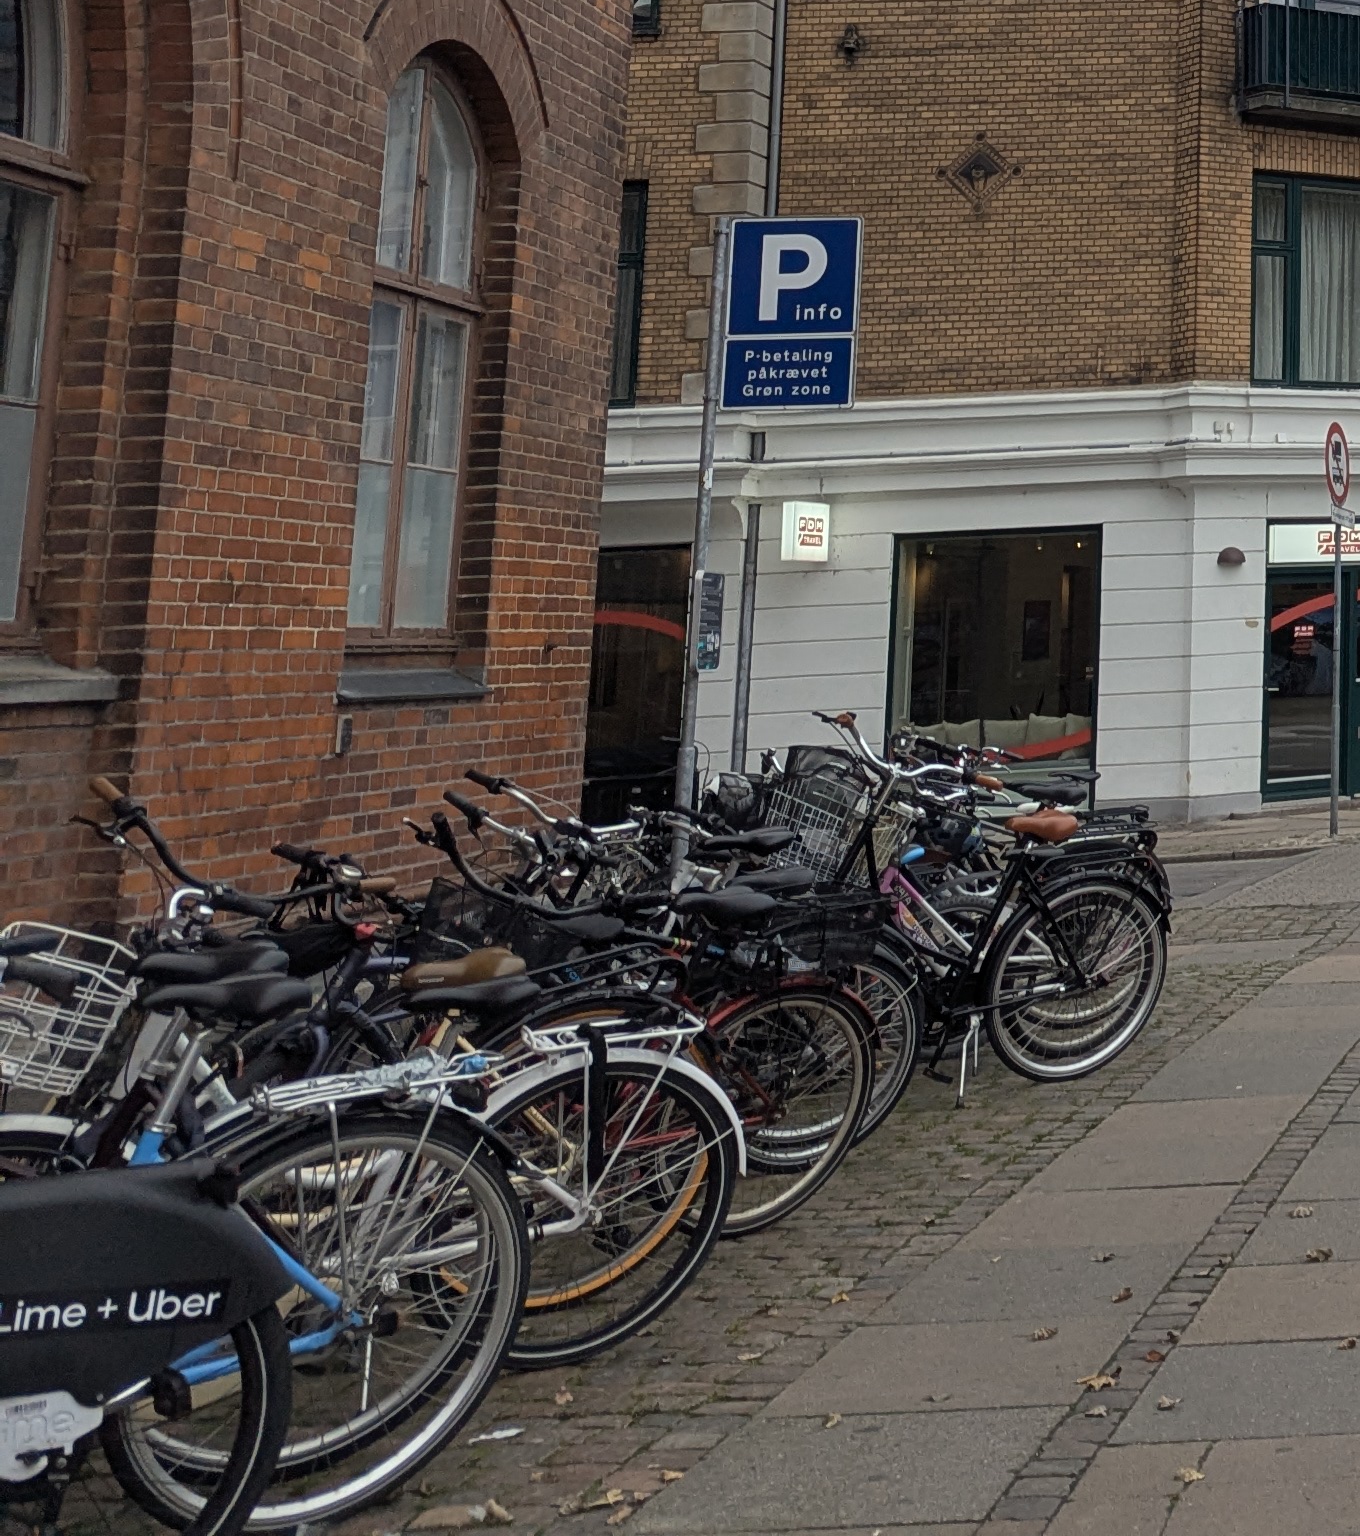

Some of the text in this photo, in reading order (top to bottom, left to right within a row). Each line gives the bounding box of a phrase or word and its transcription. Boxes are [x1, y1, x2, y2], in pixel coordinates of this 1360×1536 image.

[758, 233, 828, 321] P
[795, 303, 842, 321] info
[744, 349, 833, 363] P-betaling
[747, 365, 828, 382] påkrævet
[742, 384, 831, 397] Grøn zone
[800, 518, 823, 531] FDM
[1328, 545, 1360, 553] TAVEL
[0, 1288, 221, 1333] Lime + Uber
